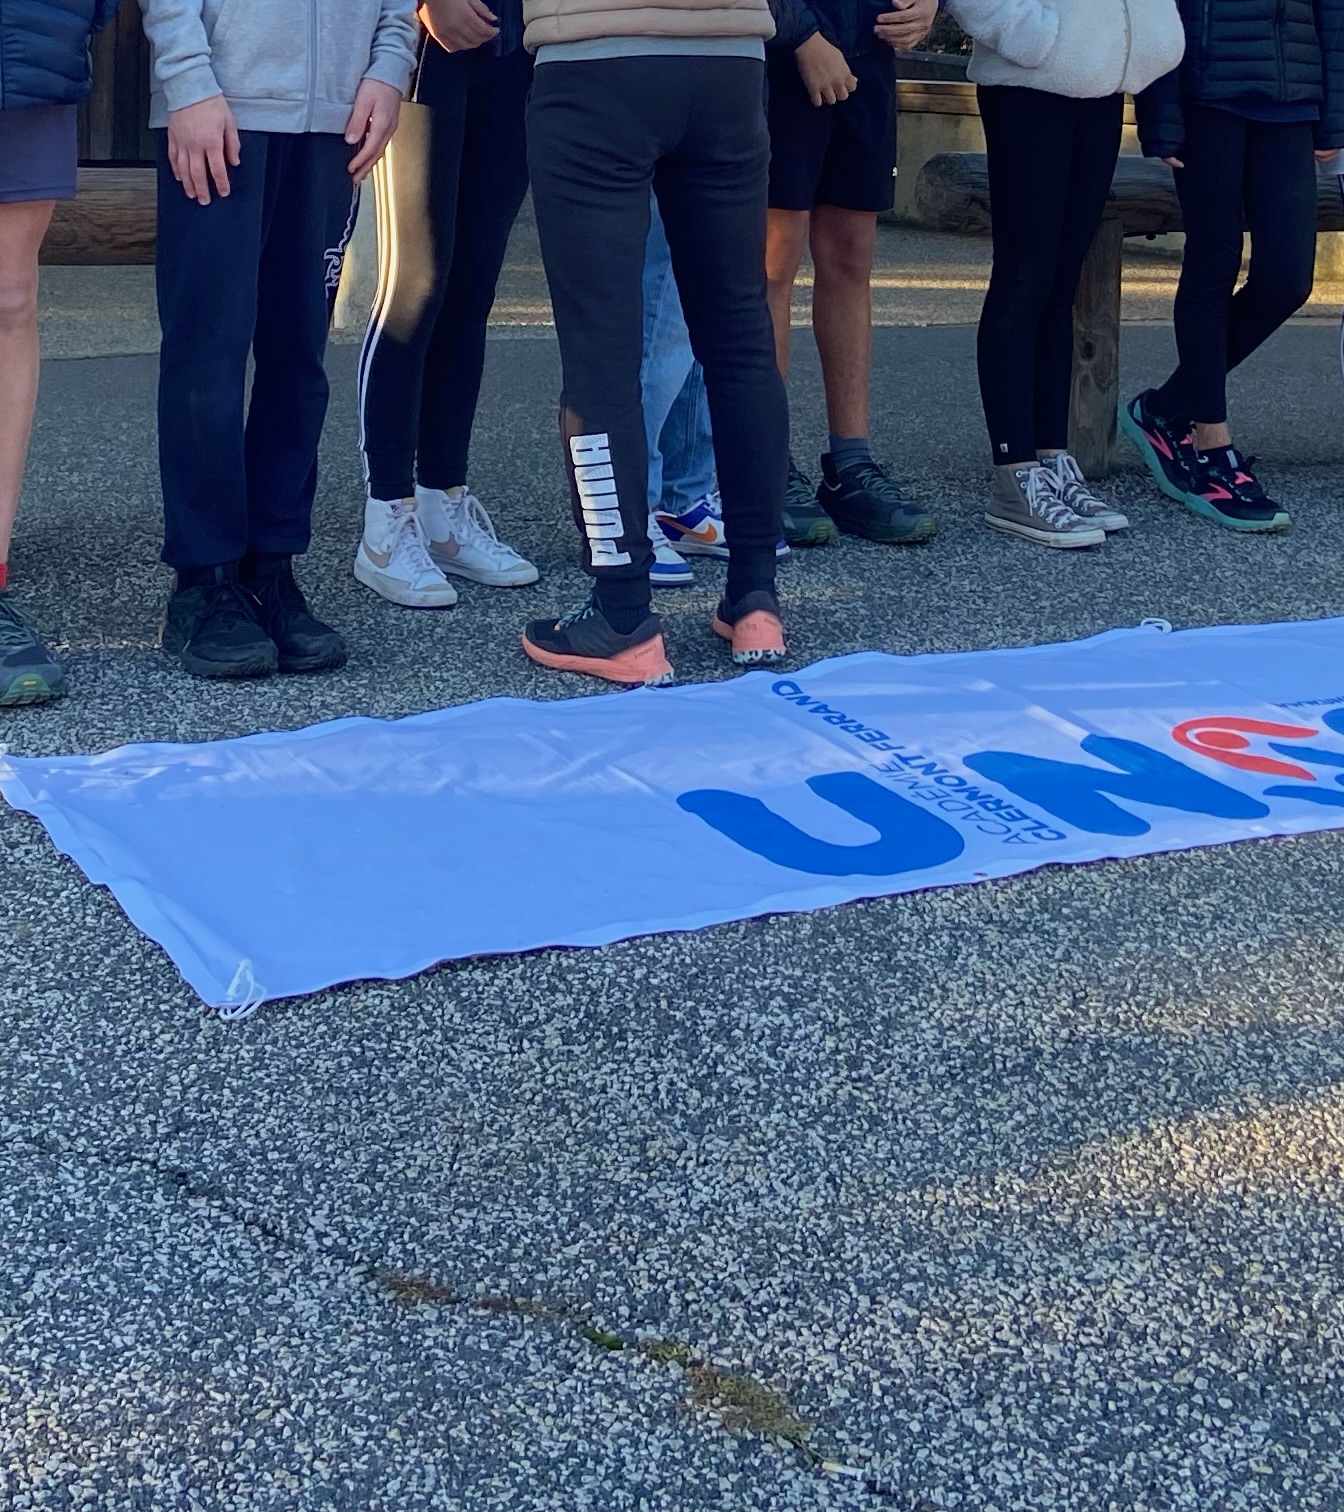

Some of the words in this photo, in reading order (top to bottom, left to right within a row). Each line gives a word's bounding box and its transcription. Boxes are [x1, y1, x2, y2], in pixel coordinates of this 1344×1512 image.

[569, 432, 633, 567] PUMA
[771, 680, 906, 752] FERRAND
[868, 760, 1040, 845] ACADÉMIE
[892, 751, 1067, 842] CLERMONT
